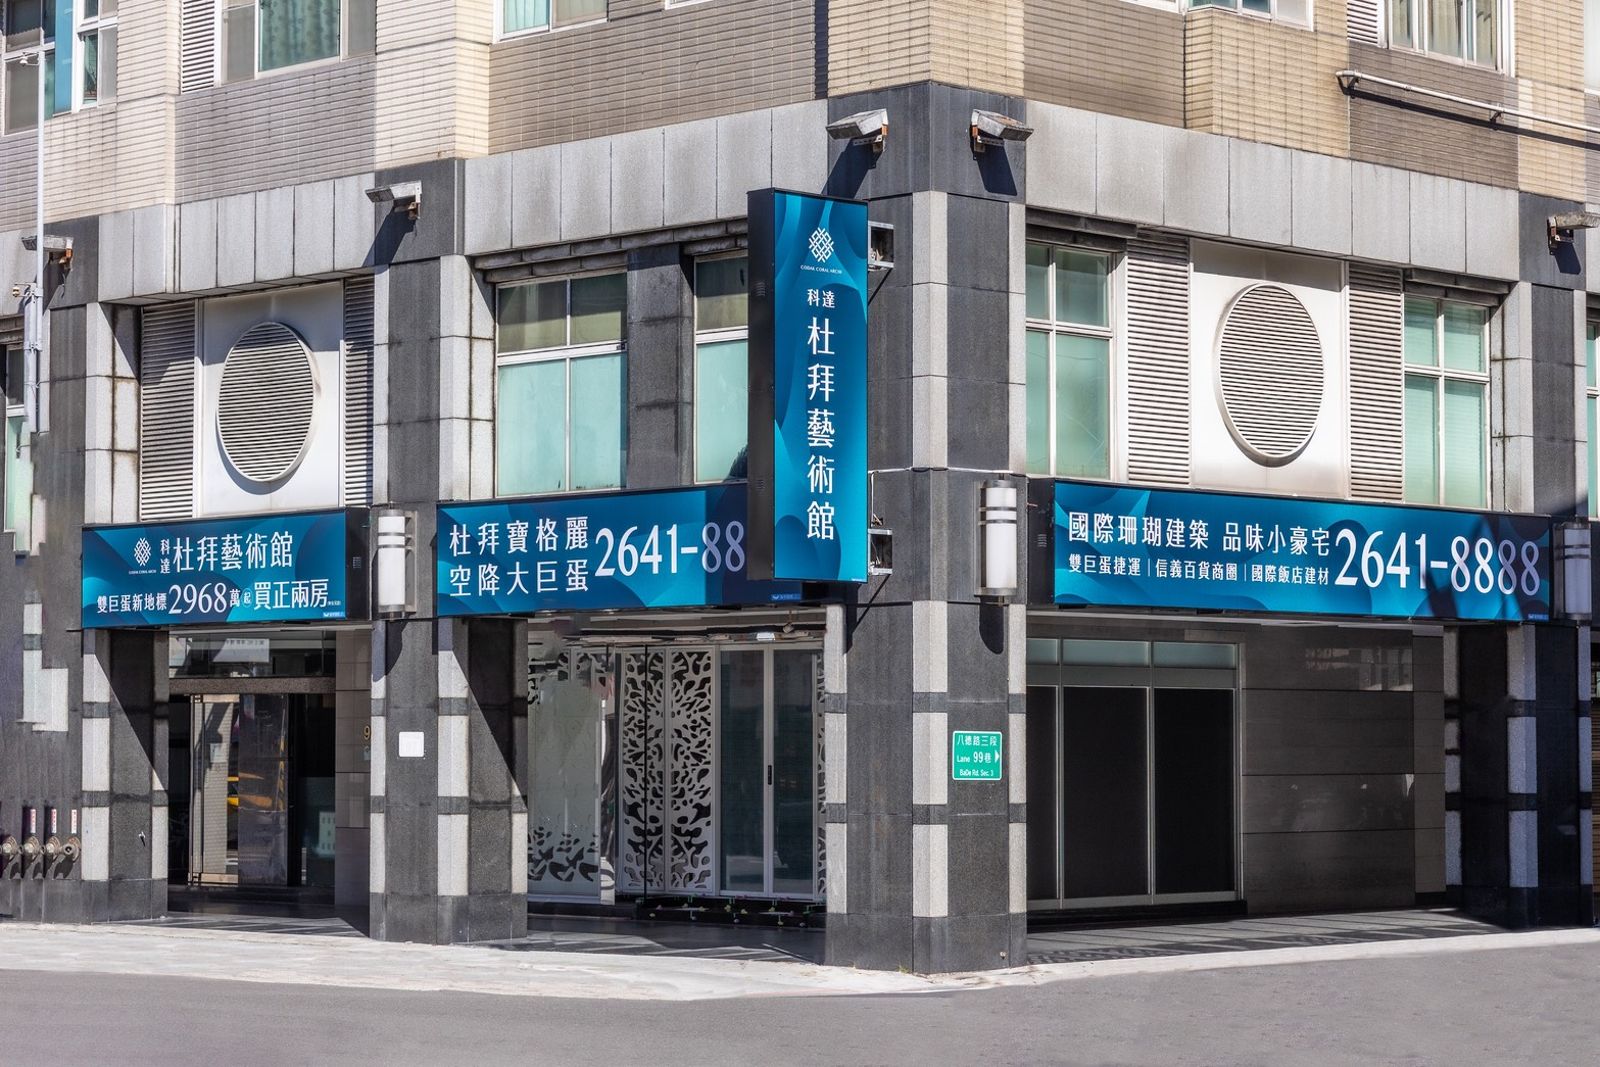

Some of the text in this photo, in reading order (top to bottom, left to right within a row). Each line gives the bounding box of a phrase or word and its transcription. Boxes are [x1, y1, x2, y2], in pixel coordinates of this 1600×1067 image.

[807, 289, 835, 308] 科達
[807, 316, 836, 540] 杜拜藝術館
[173, 530, 293, 573] 杜拜藝術館
[449, 516, 589, 557] 杜拜寶格麗
[1068, 511, 1329, 556] 國際珊瑚建築 品味小豪宅
[160, 538, 171, 574] 科達
[1068, 553, 1329, 586] 雙巨蛋捷運 信義百貨商圈 國際飯店建材
[1334, 528, 1541, 597] 2641-8888
[97, 592, 168, 614] 雙巨蛋新地標
[168, 582, 228, 615] 2968
[253, 578, 329, 610] 買正兩房
[449, 559, 589, 597] 空降大巨蛋
